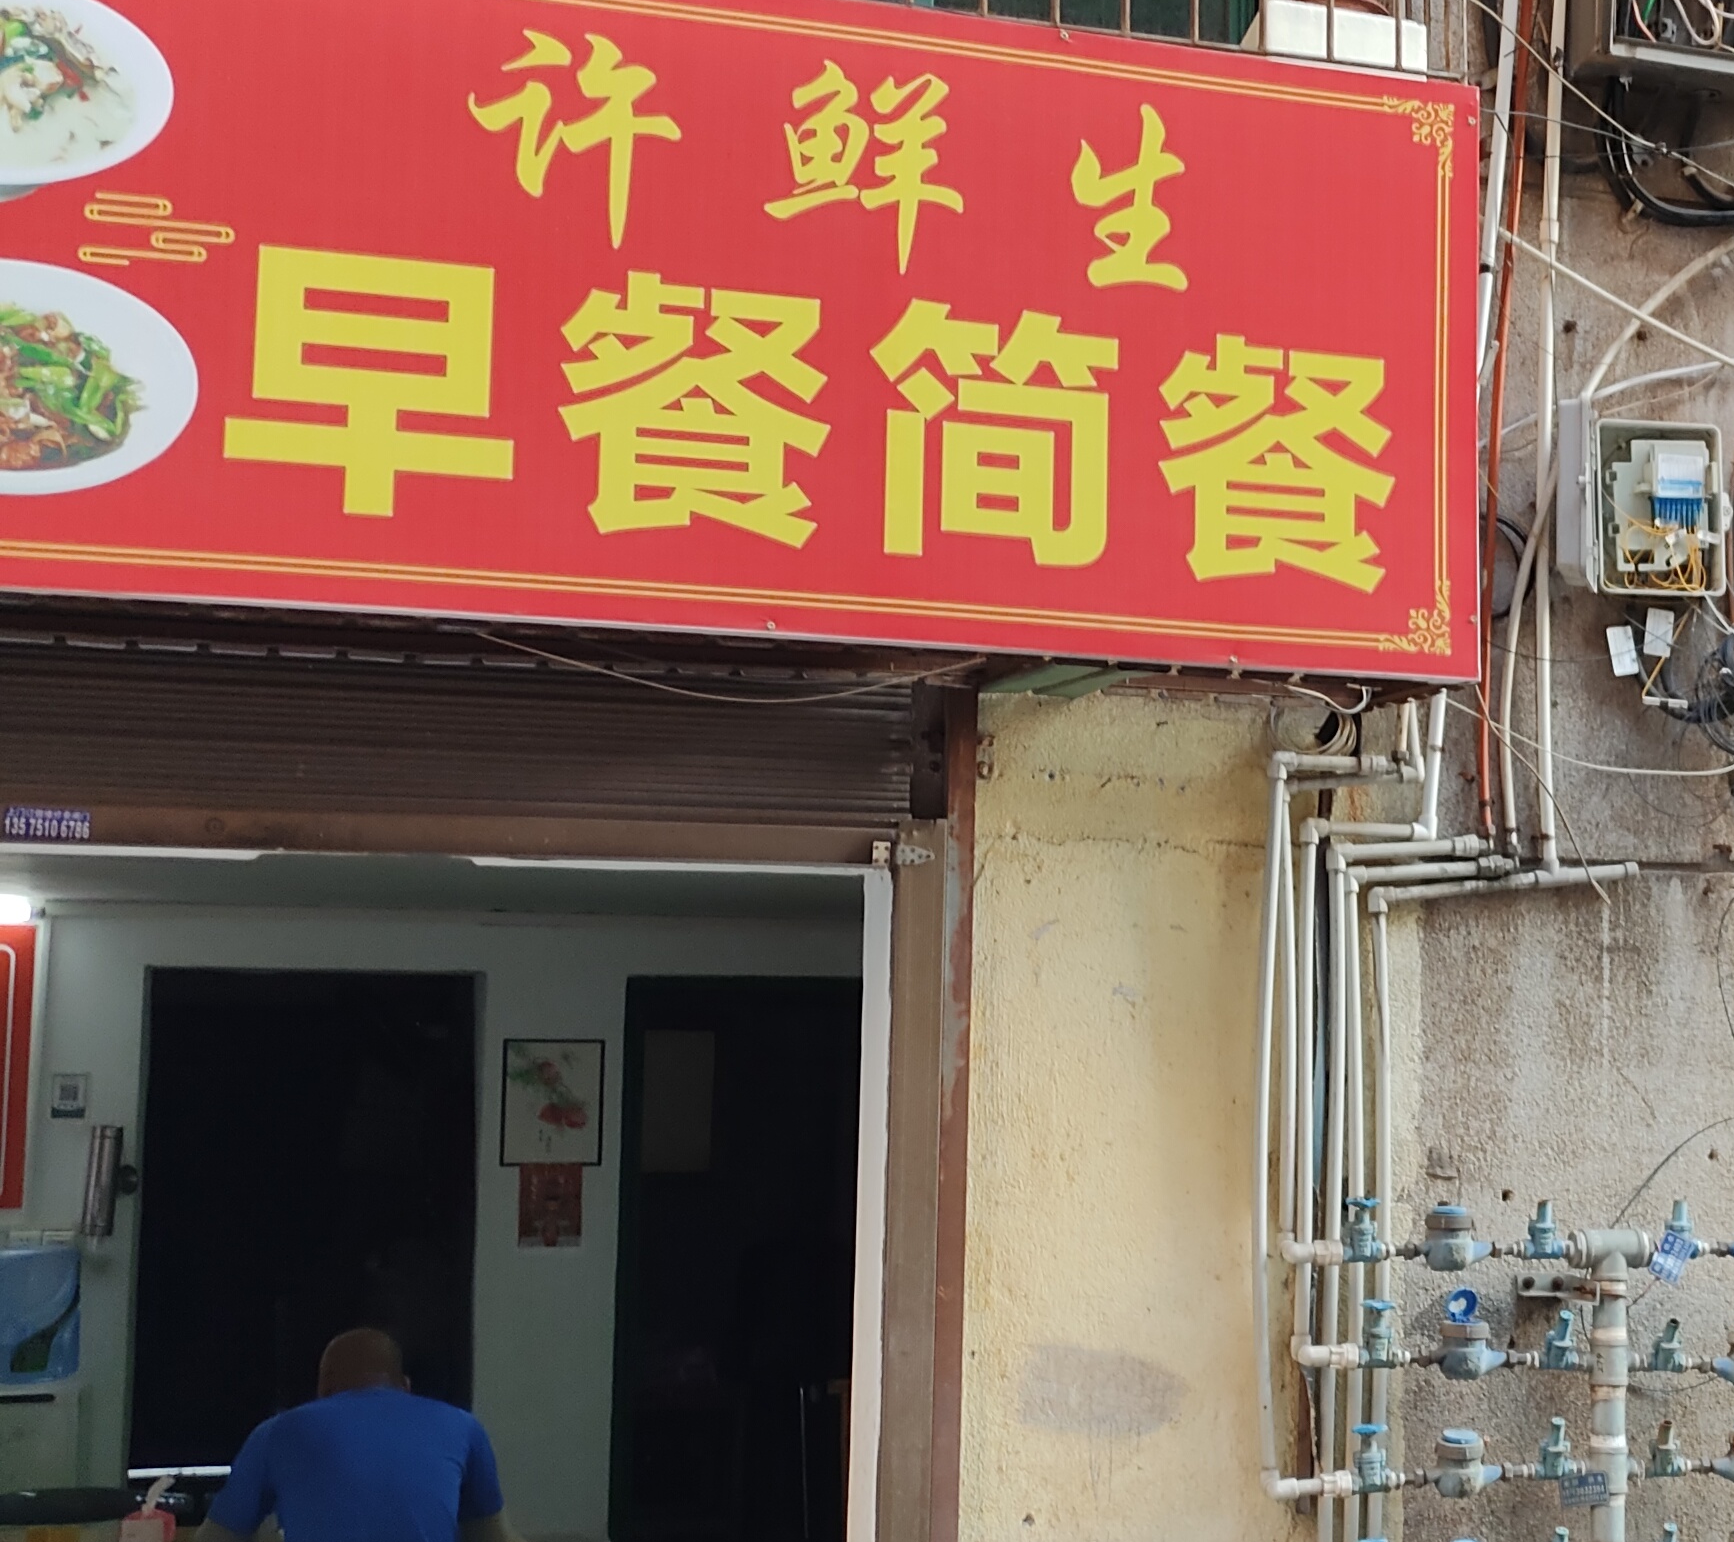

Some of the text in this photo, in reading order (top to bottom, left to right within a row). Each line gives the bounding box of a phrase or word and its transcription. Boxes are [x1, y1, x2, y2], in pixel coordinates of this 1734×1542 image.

[468, 31, 1188, 291] 许鲜生
[223, 245, 1395, 593] 早餐简餐
